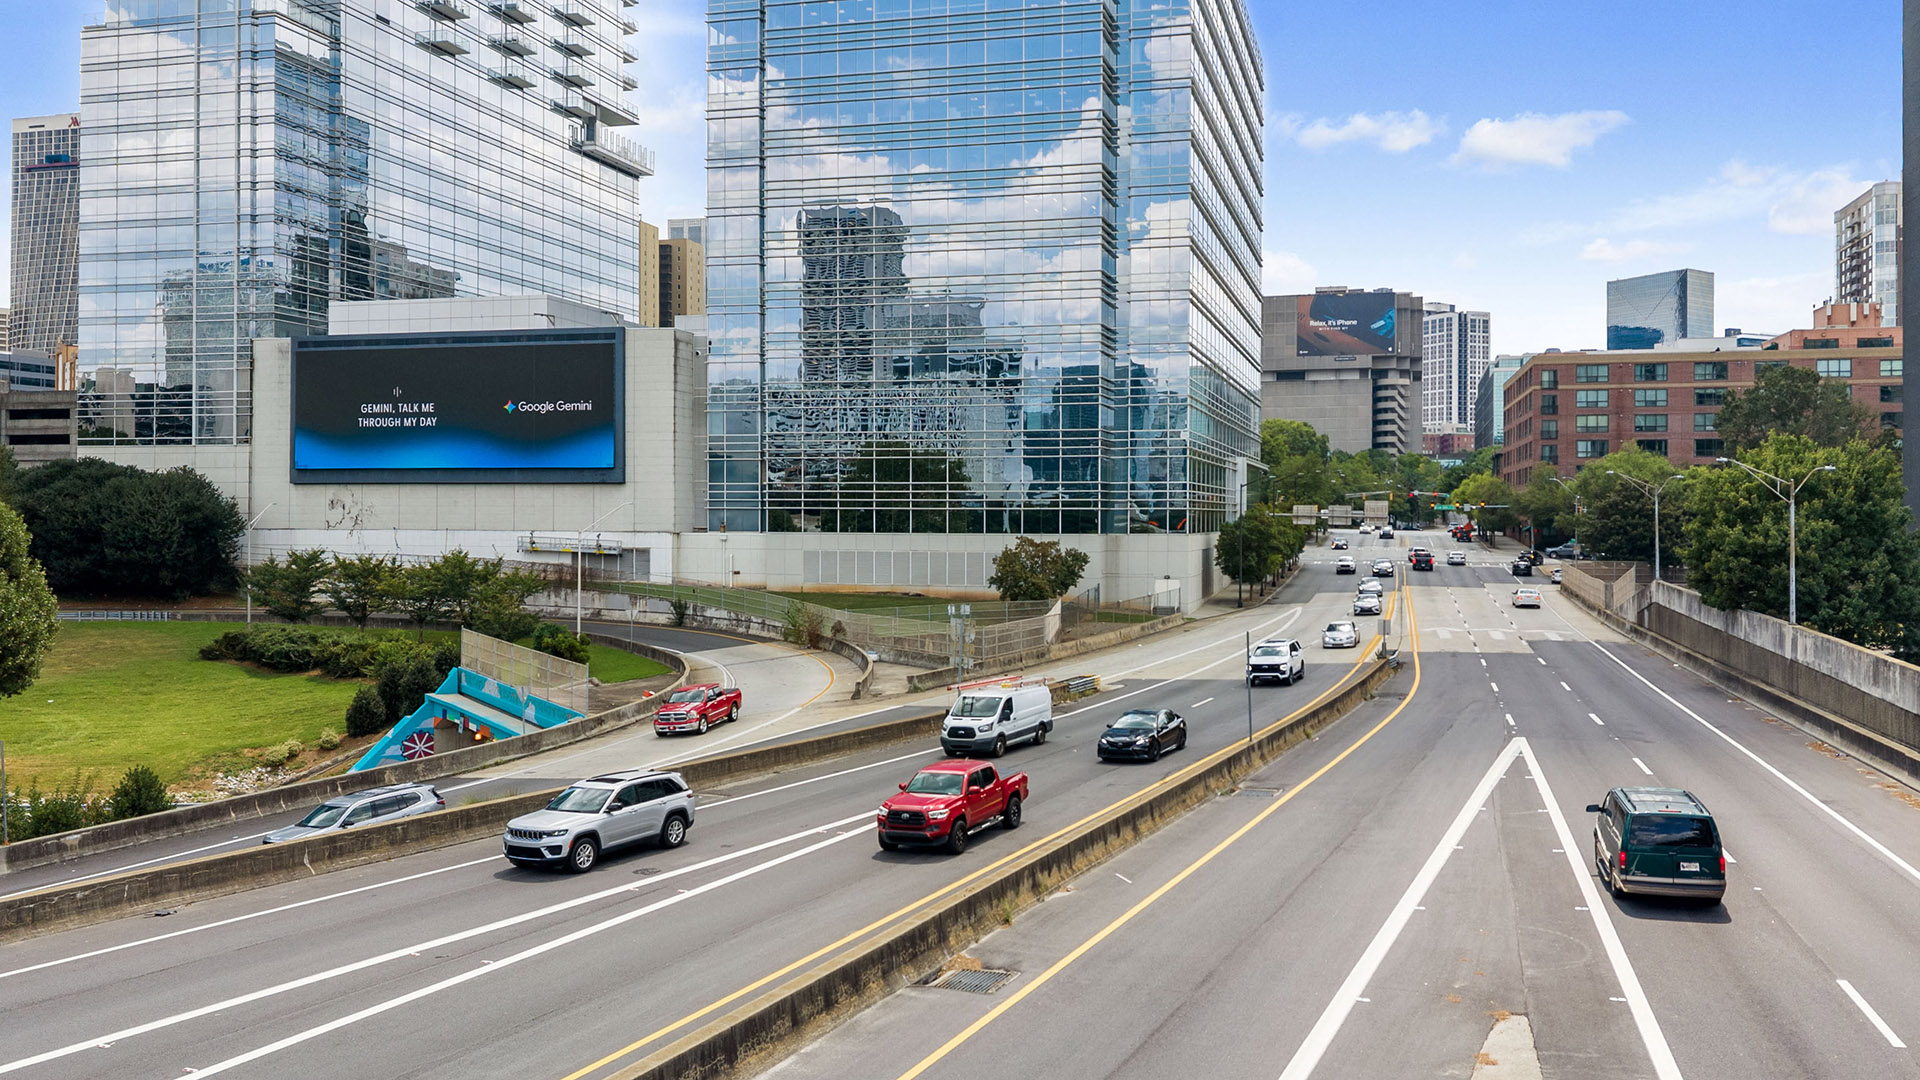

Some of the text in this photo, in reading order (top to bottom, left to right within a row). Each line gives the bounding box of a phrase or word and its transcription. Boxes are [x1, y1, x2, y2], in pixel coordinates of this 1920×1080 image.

[360, 402, 435, 414] GEMINI, TALK ME
[518, 400, 592, 414] Google Gemini
[358, 417, 437, 427] THROUGH MY DAY
